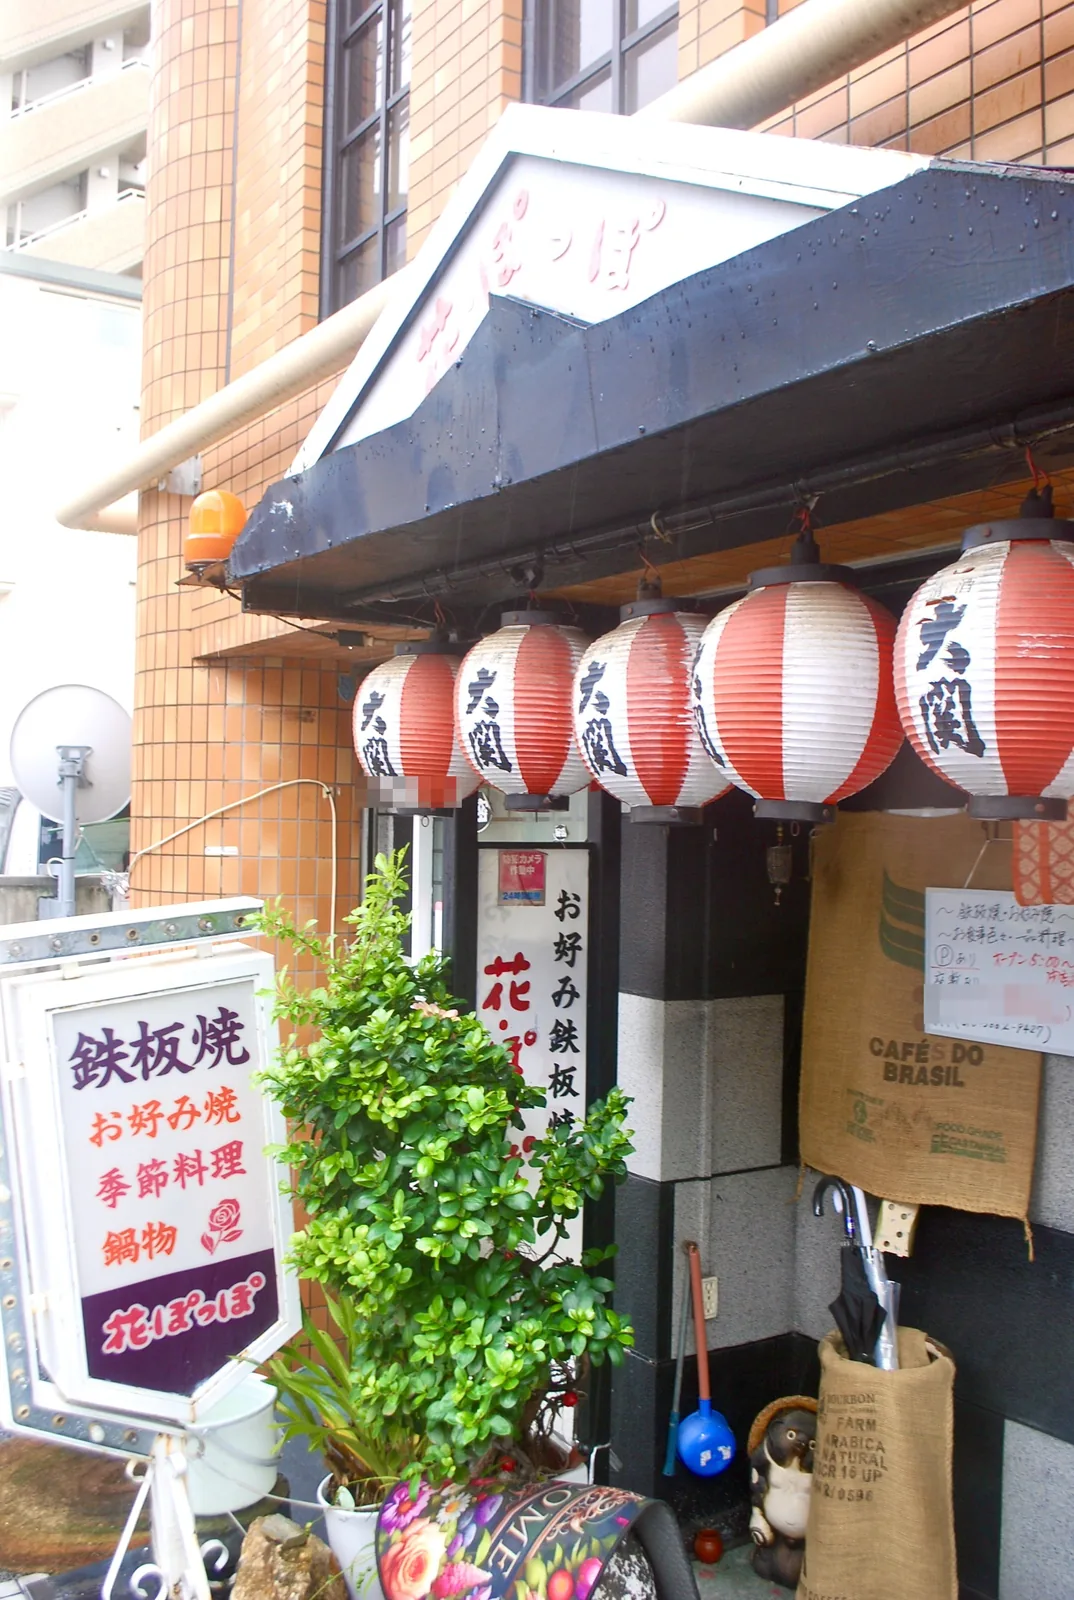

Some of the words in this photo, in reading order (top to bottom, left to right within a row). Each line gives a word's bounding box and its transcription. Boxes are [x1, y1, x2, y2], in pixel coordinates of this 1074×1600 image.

[69, 1006, 250, 1091] 鉄板焼
[951, 1042, 984, 1066] DO
[883, 1061, 964, 1087] BRASIL
[89, 1086, 242, 1147] お好み焼
[96, 1140, 248, 1208] 季節料理
[102, 1221, 178, 1266] 鍋物
[837, 1417, 877, 1431] FARM
[862, 1468, 883, 1482] UP
